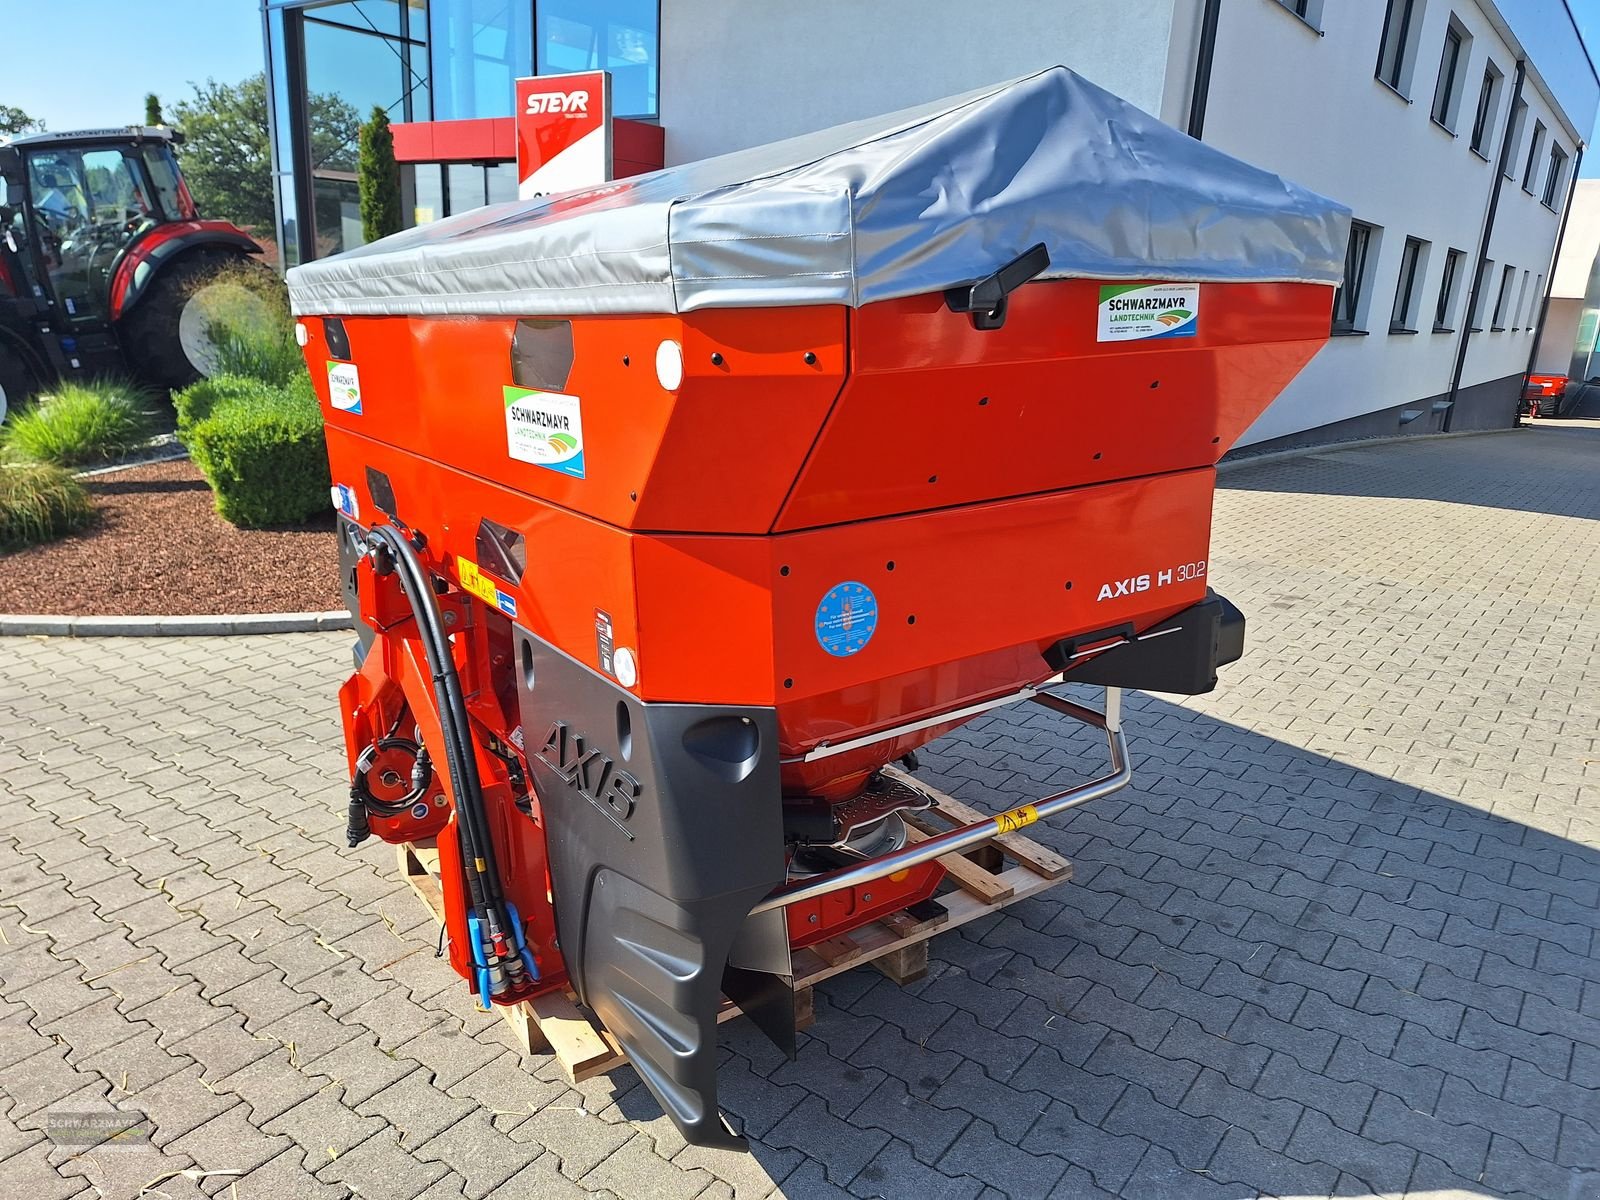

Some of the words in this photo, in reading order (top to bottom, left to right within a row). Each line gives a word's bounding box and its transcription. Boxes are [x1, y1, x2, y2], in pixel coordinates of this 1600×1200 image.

[526, 90, 589, 115] STEYR
[1108, 297, 1186, 311] SCHWARZMAYR
[1109, 313, 1155, 322] LANDTECHNIK
[511, 406, 570, 431] SCHWARZMAYR
[1096, 574, 1151, 602] AXIS
[1157, 568, 1172, 587] H
[1176, 560, 1206, 582] 30.2
[534, 720, 641, 821] AXIS
